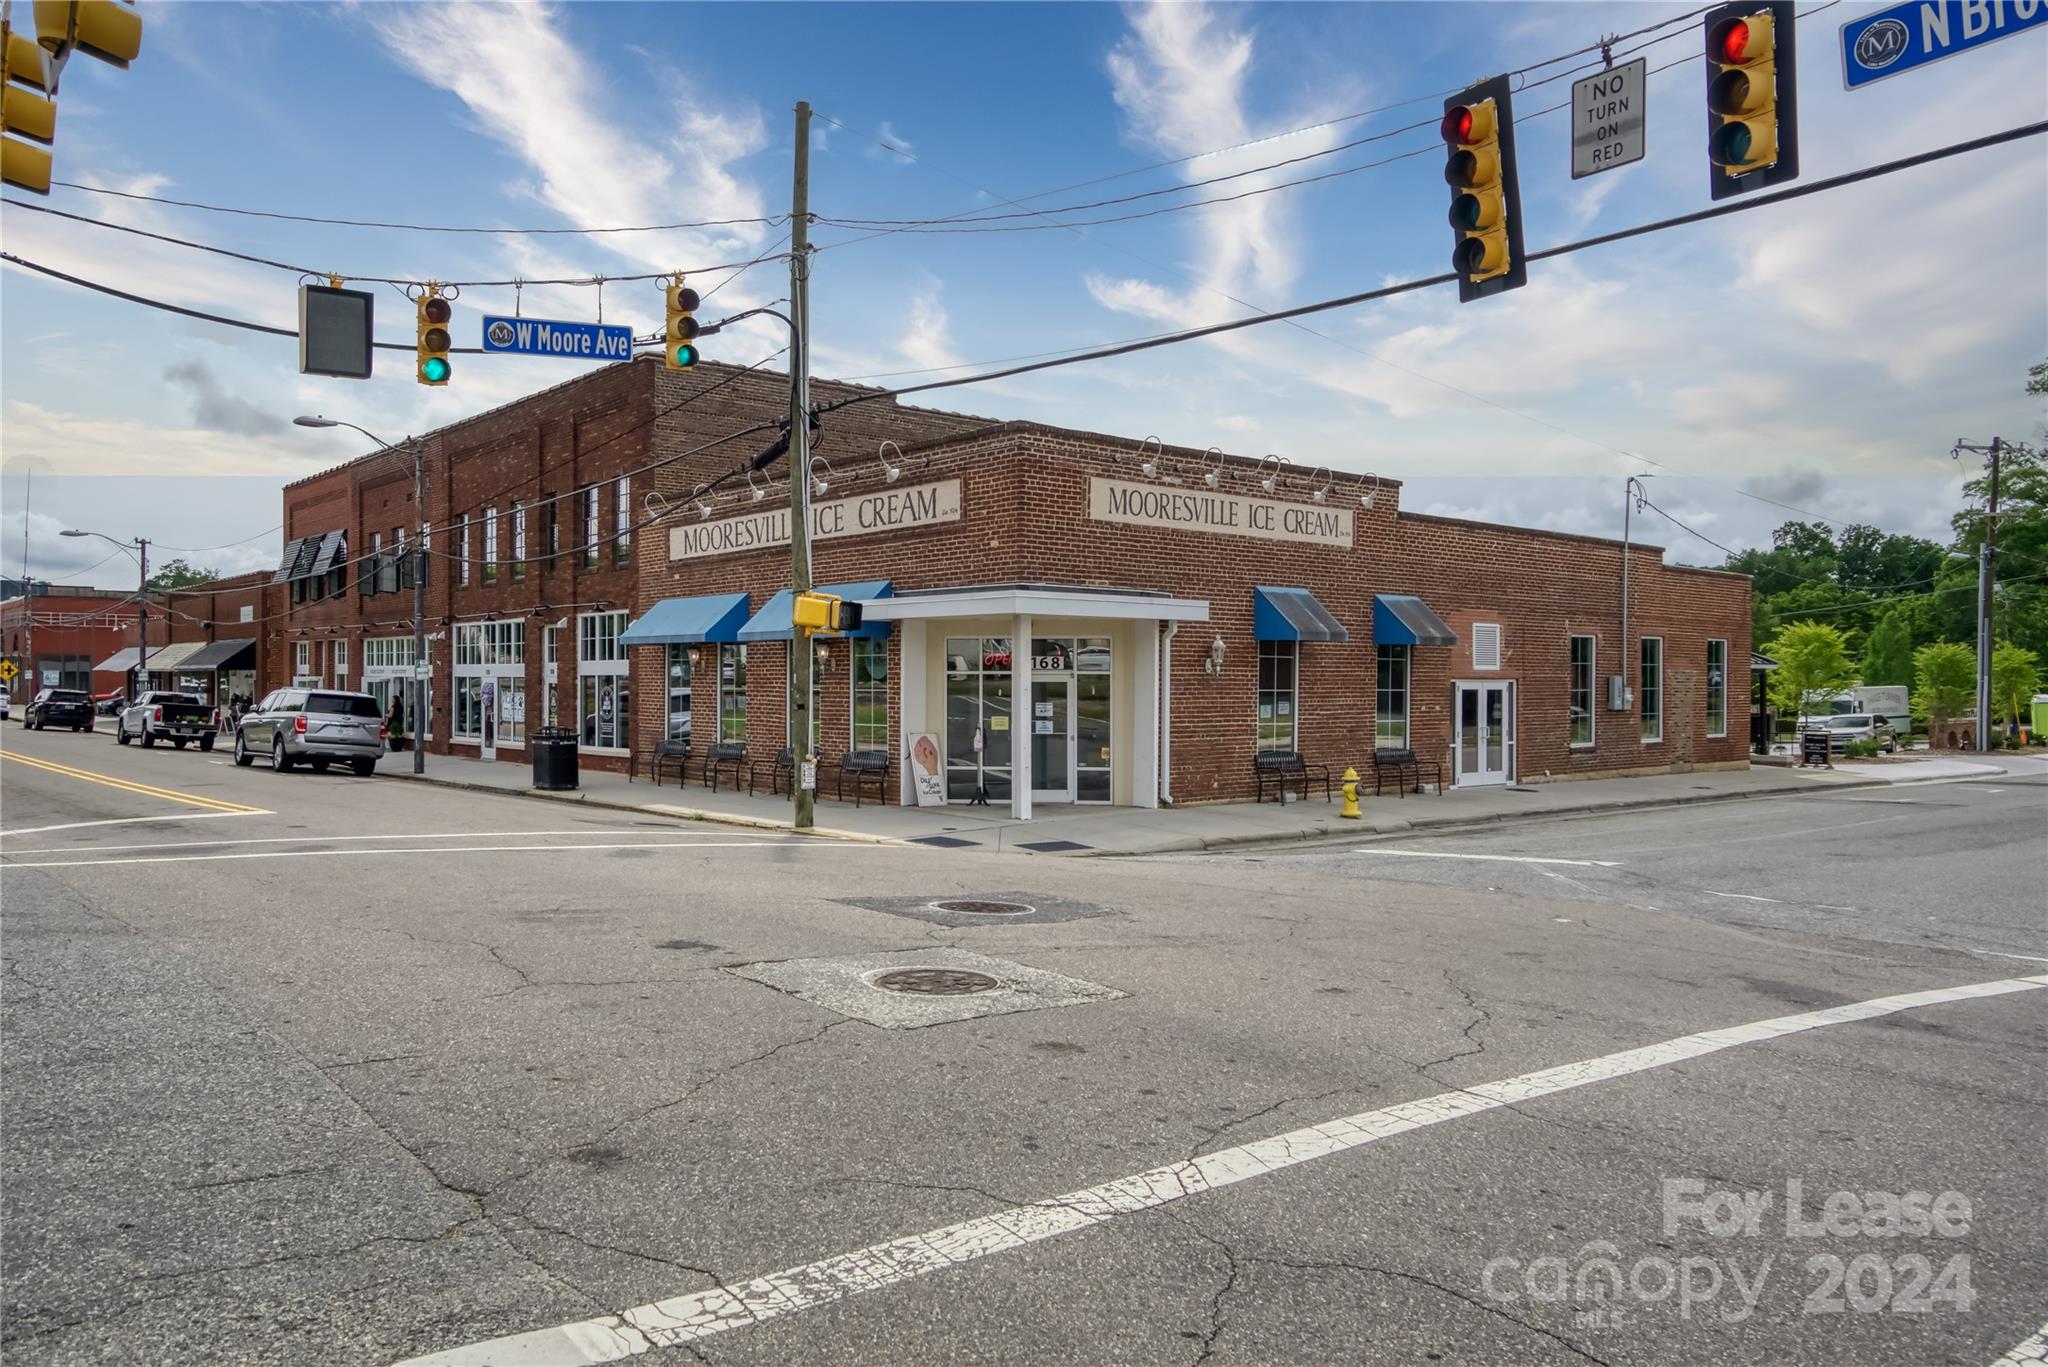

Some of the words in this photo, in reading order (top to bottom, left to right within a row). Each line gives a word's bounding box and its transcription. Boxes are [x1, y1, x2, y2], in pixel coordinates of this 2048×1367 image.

[1920, 0, 1950, 54] N
[1593, 75, 1624, 100] NO
[1587, 97, 1629, 123] TURN
[1597, 122, 1618, 141] ON
[1593, 142, 1623, 163] RED
[516, 322, 533, 350] W
[537, 324, 591, 354] Moore
[595, 329, 628, 357] Ave
[683, 513, 791, 555] MOORESVILL
[813, 504, 844, 536] ICE
[858, 487, 937, 529] CREAM
[1108, 487, 1238, 527] MOORESVILLE
[1249, 504, 1276, 532] ICE
[1284, 509, 1339, 538] CREAM
[984, 653, 1012, 667] OPE
[1031, 657, 1061, 669] 168
